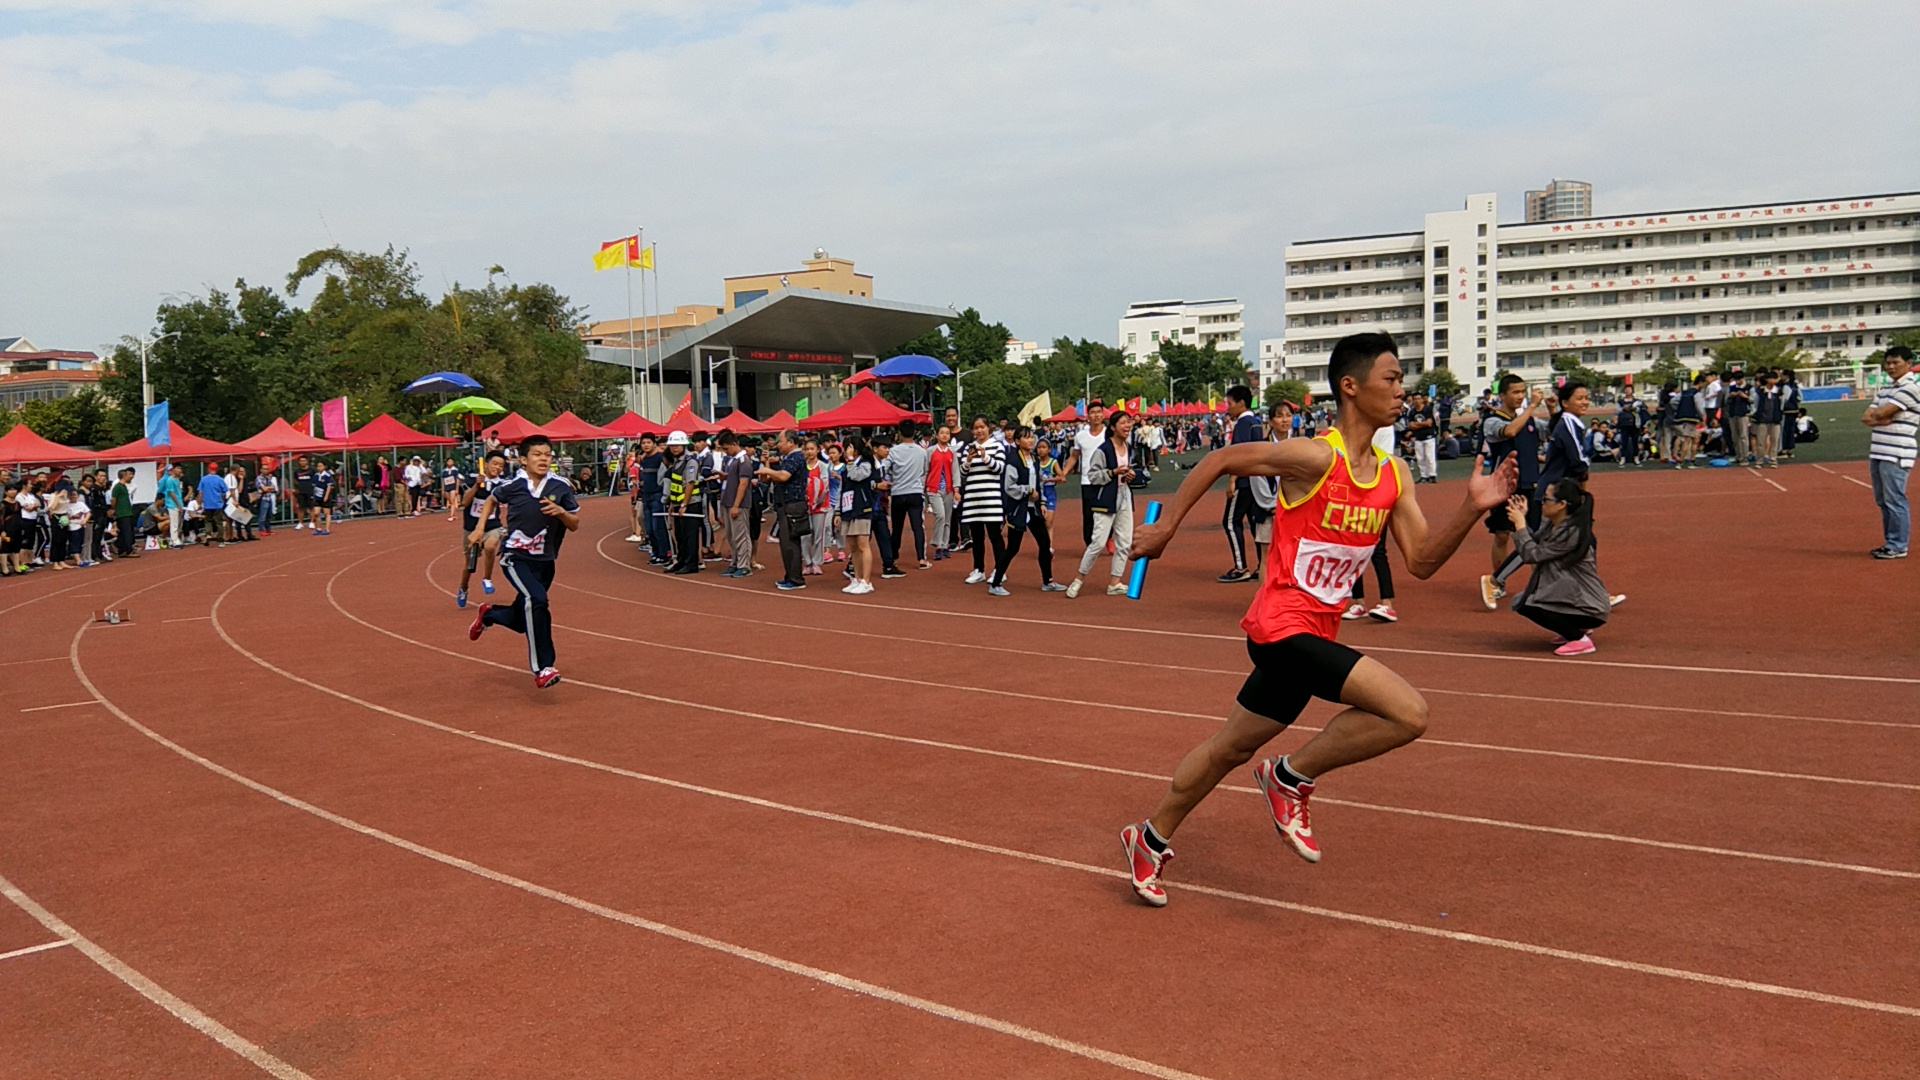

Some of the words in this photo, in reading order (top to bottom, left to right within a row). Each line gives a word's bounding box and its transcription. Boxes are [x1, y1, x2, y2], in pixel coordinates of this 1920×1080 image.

[1550, 336, 1611, 349] 以人为本
[1320, 501, 1390, 535] CHIN
[148, 535, 156, 548] 3
